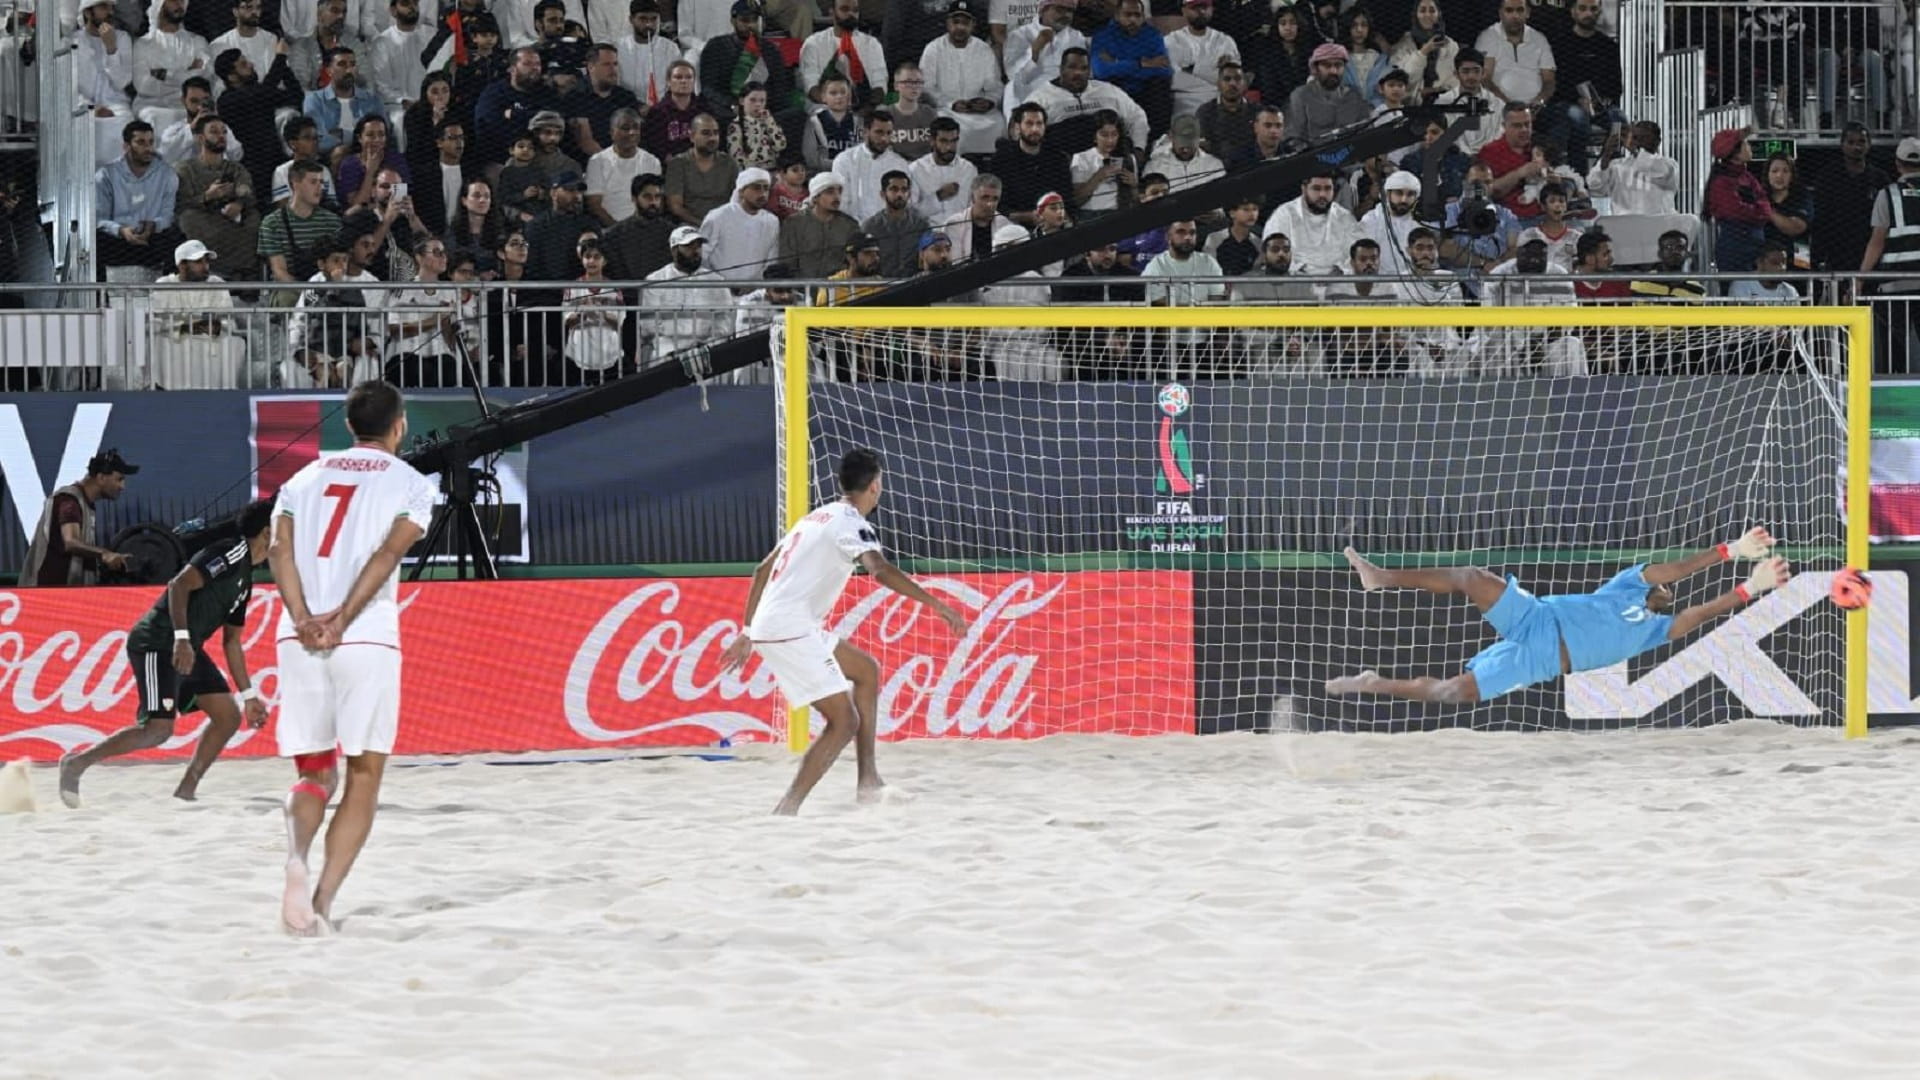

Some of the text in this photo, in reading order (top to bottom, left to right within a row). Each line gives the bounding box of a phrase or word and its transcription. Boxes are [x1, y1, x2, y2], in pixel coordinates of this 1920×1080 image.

[1008, 4, 1038, 16] BROOKLY
[1156, 502, 1192, 515] FIFA
[317, 484, 359, 558] 7
[1152, 516, 1179, 524] SOCCER
[1181, 515, 1208, 523] WORLD
[1209, 515, 1224, 523] CUP
[1127, 526, 1223, 540] UAE 2024
[1151, 543, 1196, 553] DUBAI
[564, 577, 1065, 740] CocaCola
